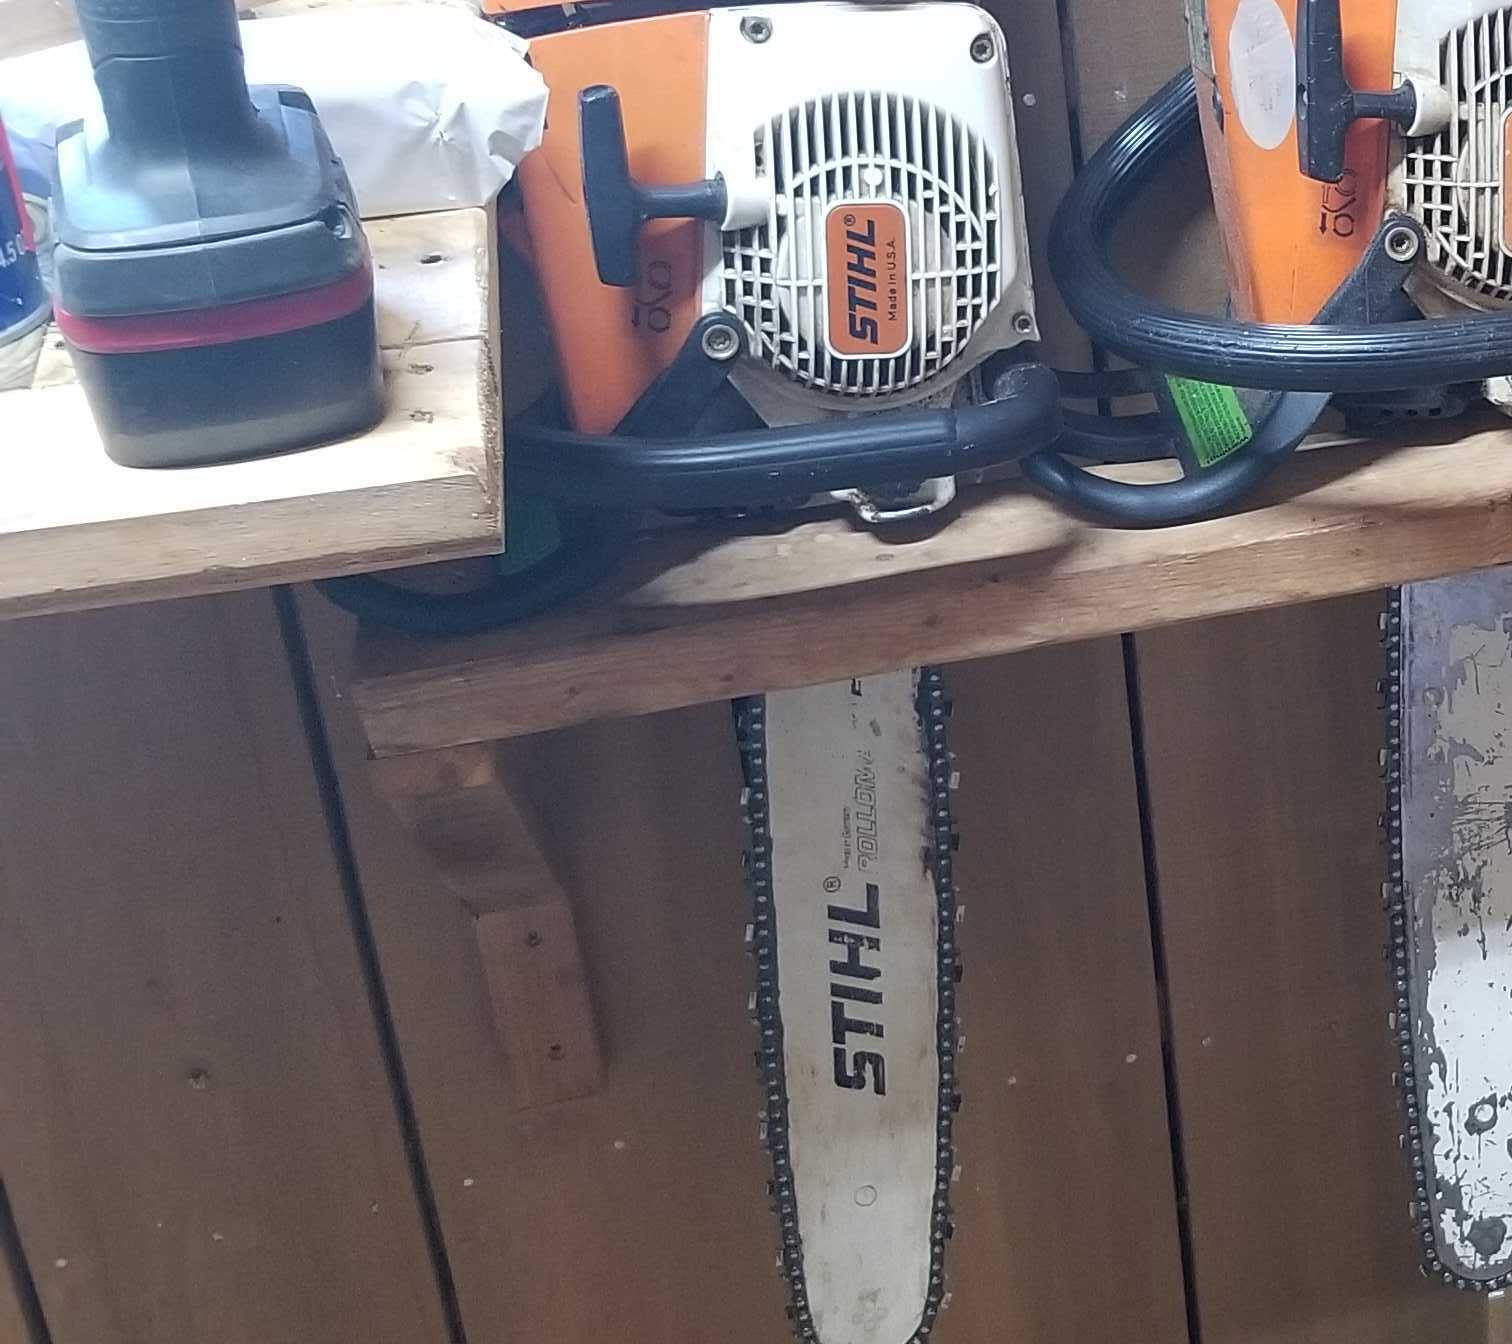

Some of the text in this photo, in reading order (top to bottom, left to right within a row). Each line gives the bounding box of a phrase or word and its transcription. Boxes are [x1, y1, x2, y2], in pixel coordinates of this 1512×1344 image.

[846, 218, 878, 345] STIHL
[887, 287, 897, 321] Made
[827, 883, 886, 1097] STIHL
